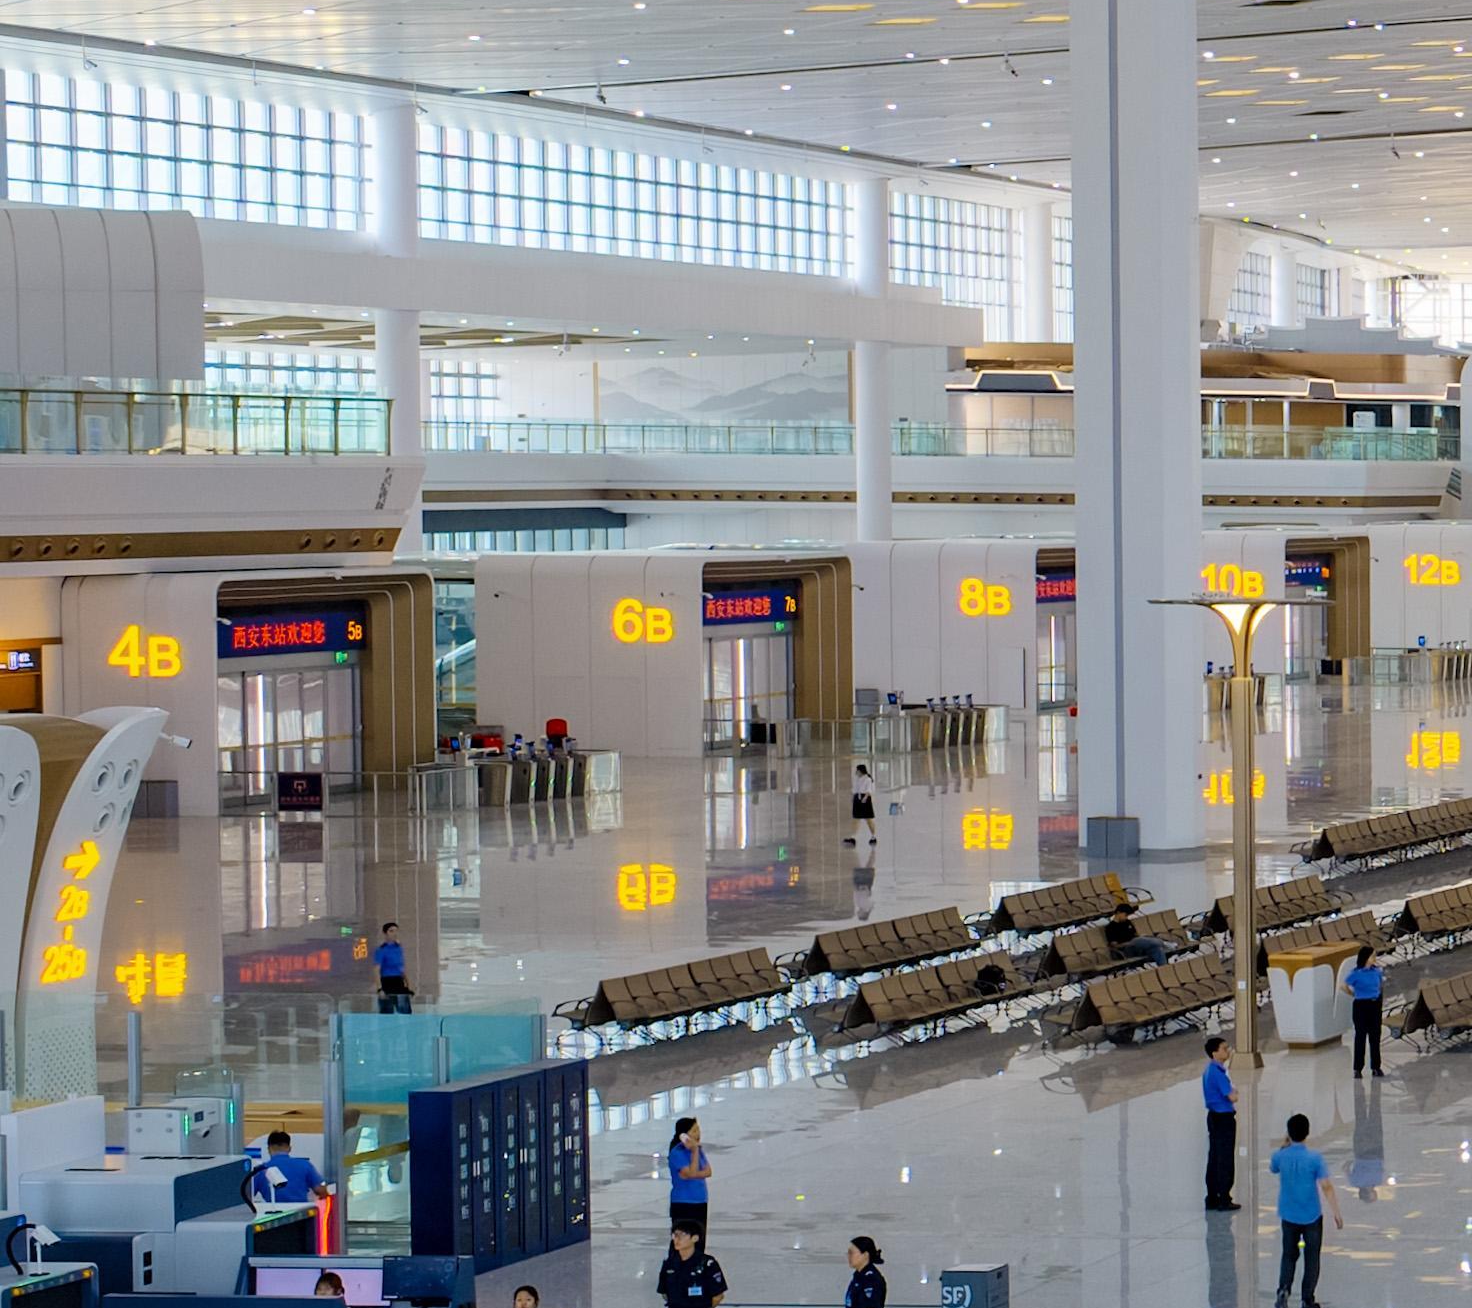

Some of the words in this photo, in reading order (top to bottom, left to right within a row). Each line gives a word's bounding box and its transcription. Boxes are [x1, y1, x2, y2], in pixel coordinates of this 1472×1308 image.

[1202, 563, 1265, 598] 10B
[1404, 554, 1461, 585] 12B
[784, 595, 796, 612] 7B
[959, 578, 1012, 617] 8B
[233, 620, 325, 649] 西安东站欢迎您
[347, 620, 363, 641] 5B
[611, 597, 675, 643] 6B
[107, 624, 183, 678] 4B
[56, 884, 90, 923] 2B
[40, 943, 87, 985] 25B
